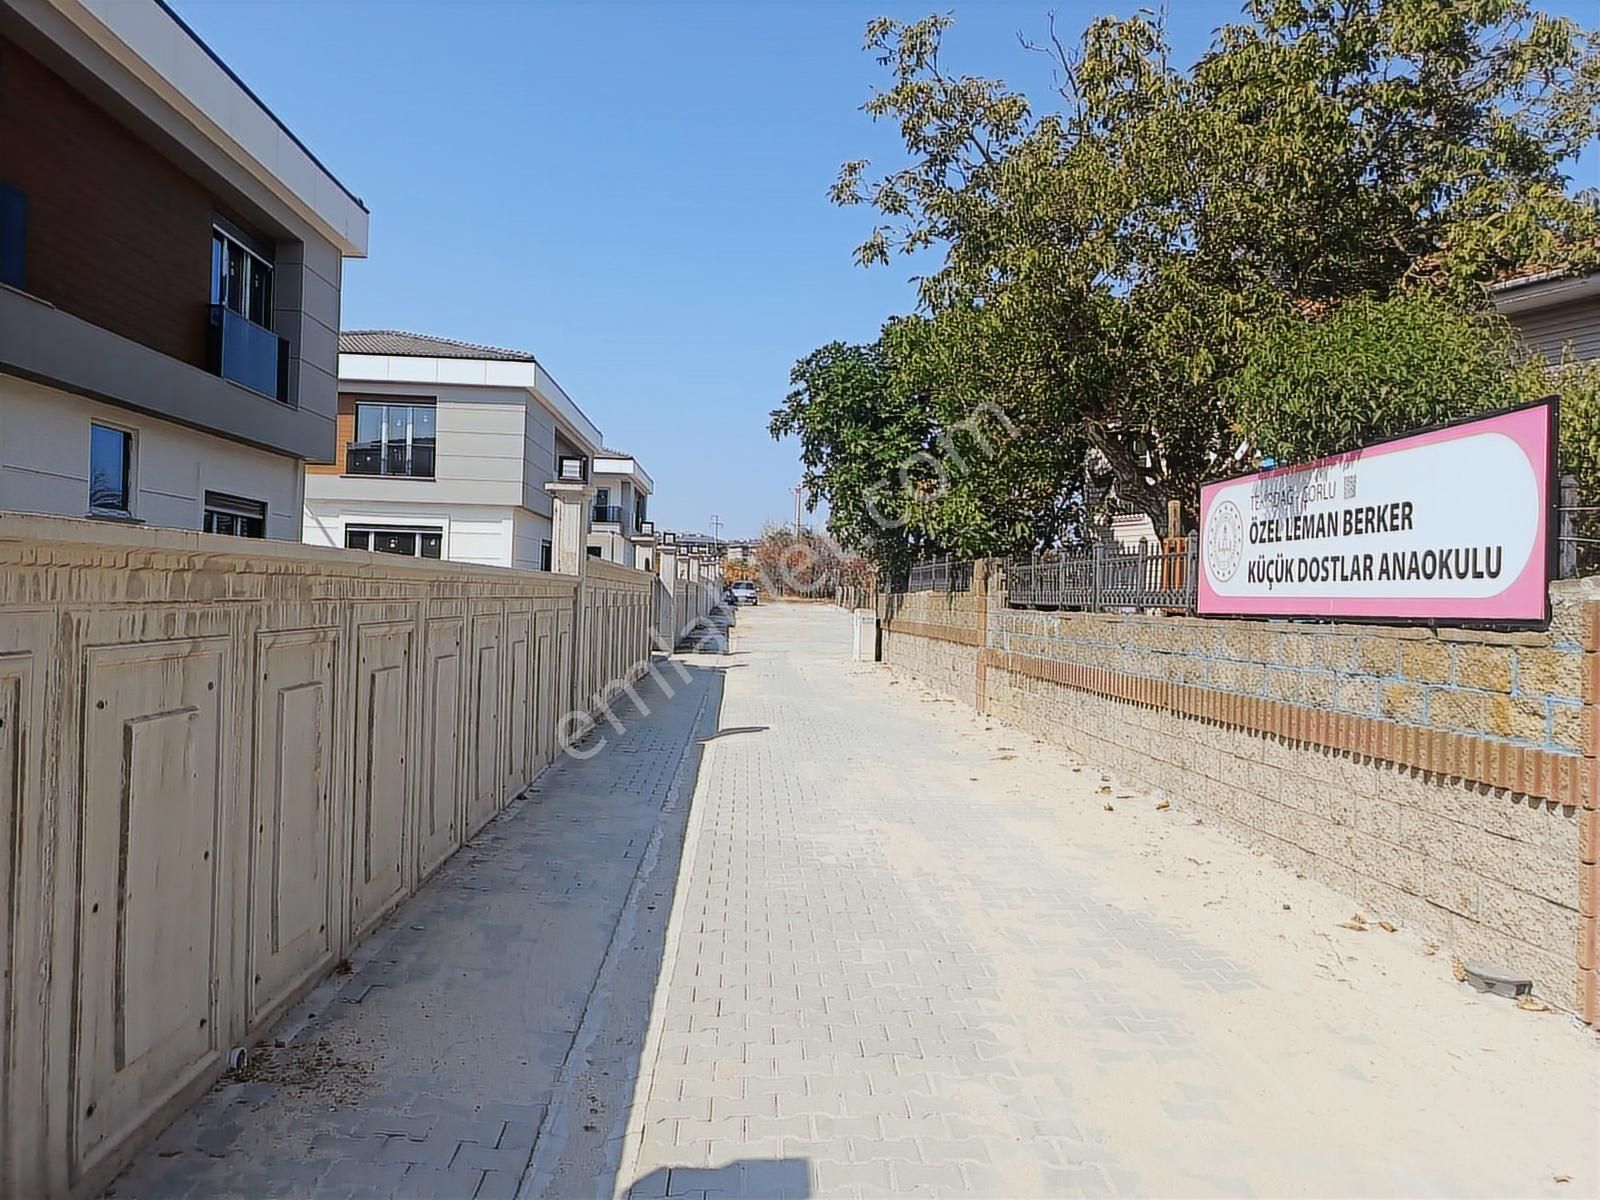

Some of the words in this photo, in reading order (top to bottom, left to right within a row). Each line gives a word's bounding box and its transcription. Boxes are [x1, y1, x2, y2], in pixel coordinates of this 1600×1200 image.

[1249, 517, 1282, 545] ÖZEL
[1285, 511, 1338, 541] LEMAN
[1343, 501, 1413, 536] BERKER
[1248, 554, 1294, 590] KÜÇÜK
[1299, 554, 1373, 582] DOSTLAR
[1379, 546, 1502, 581] ANAOKULU
